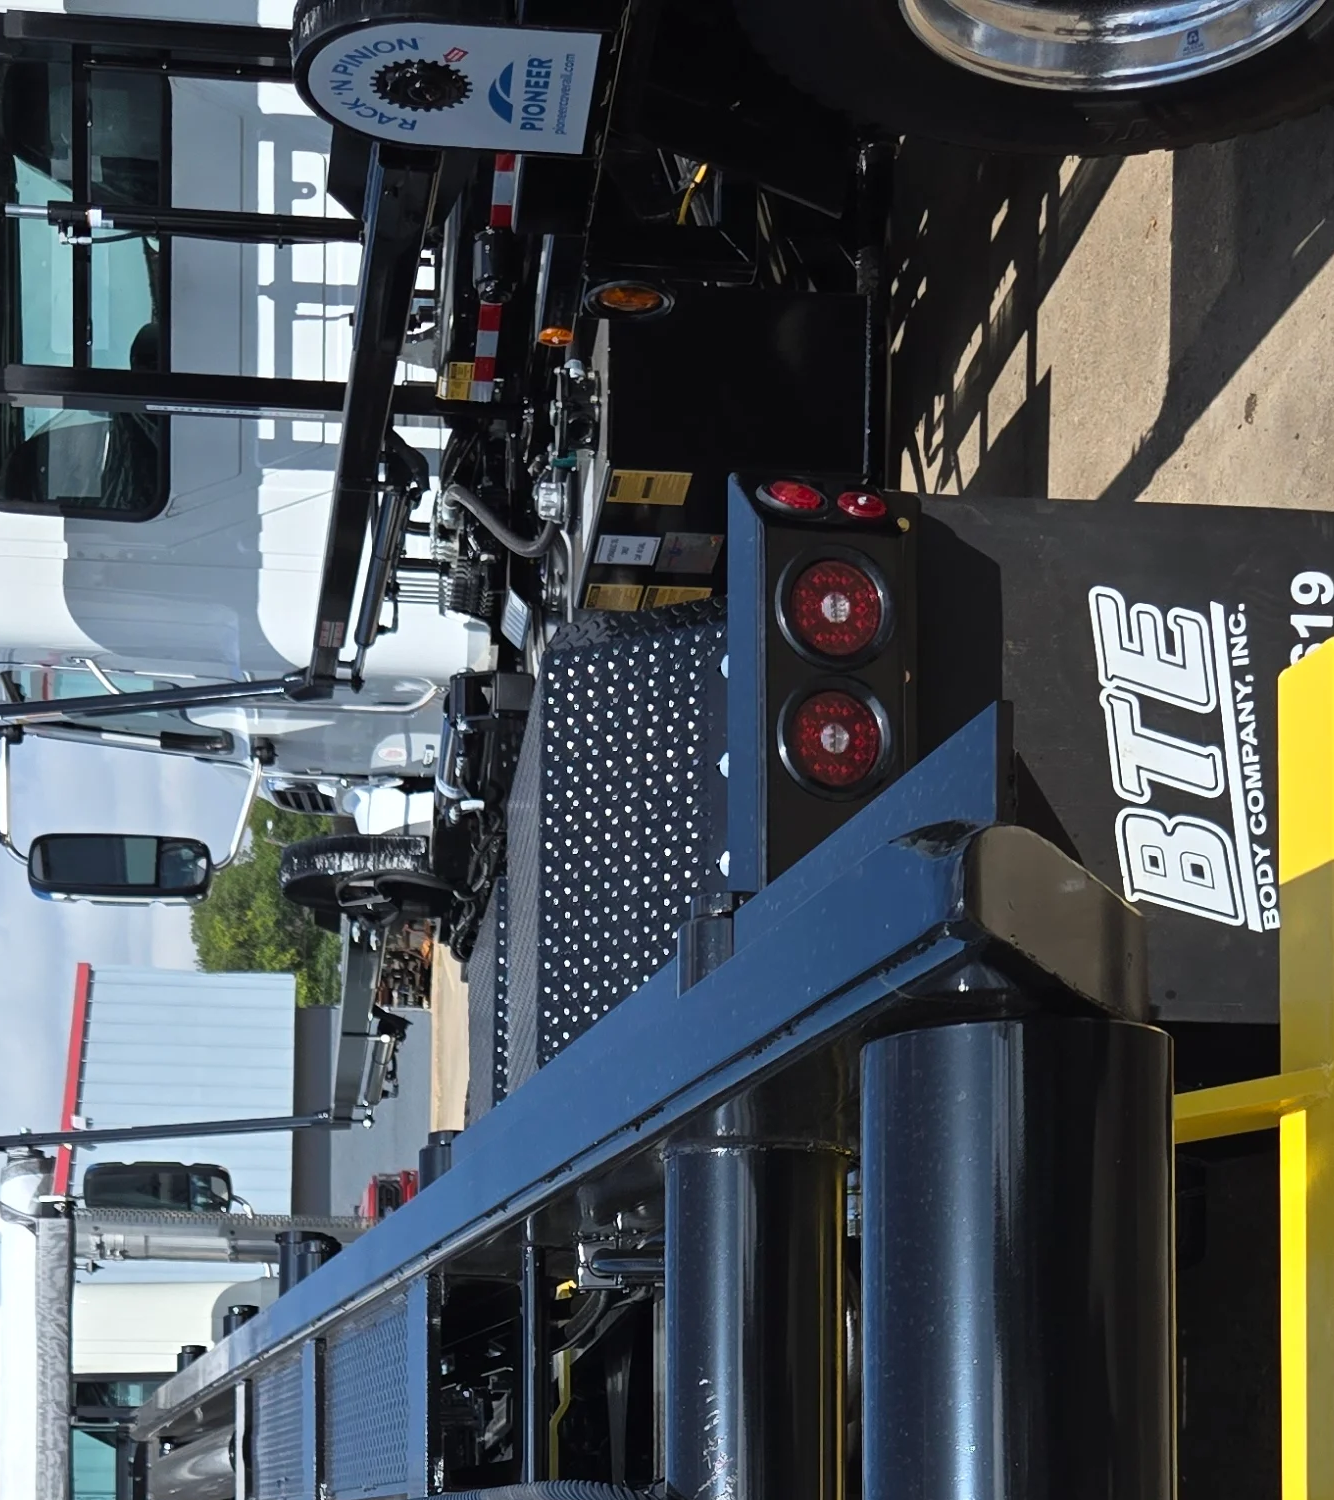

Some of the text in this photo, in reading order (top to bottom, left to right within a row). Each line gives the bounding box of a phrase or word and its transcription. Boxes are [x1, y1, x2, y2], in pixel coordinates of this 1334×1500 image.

[331, 38, 419, 76] PINION
[520, 57, 553, 131] PIONEER
[340, 97, 417, 131] RACK
[1088, 586, 1245, 926] BTE
[1228, 603, 1281, 930] BODY COMPANY, INC.
